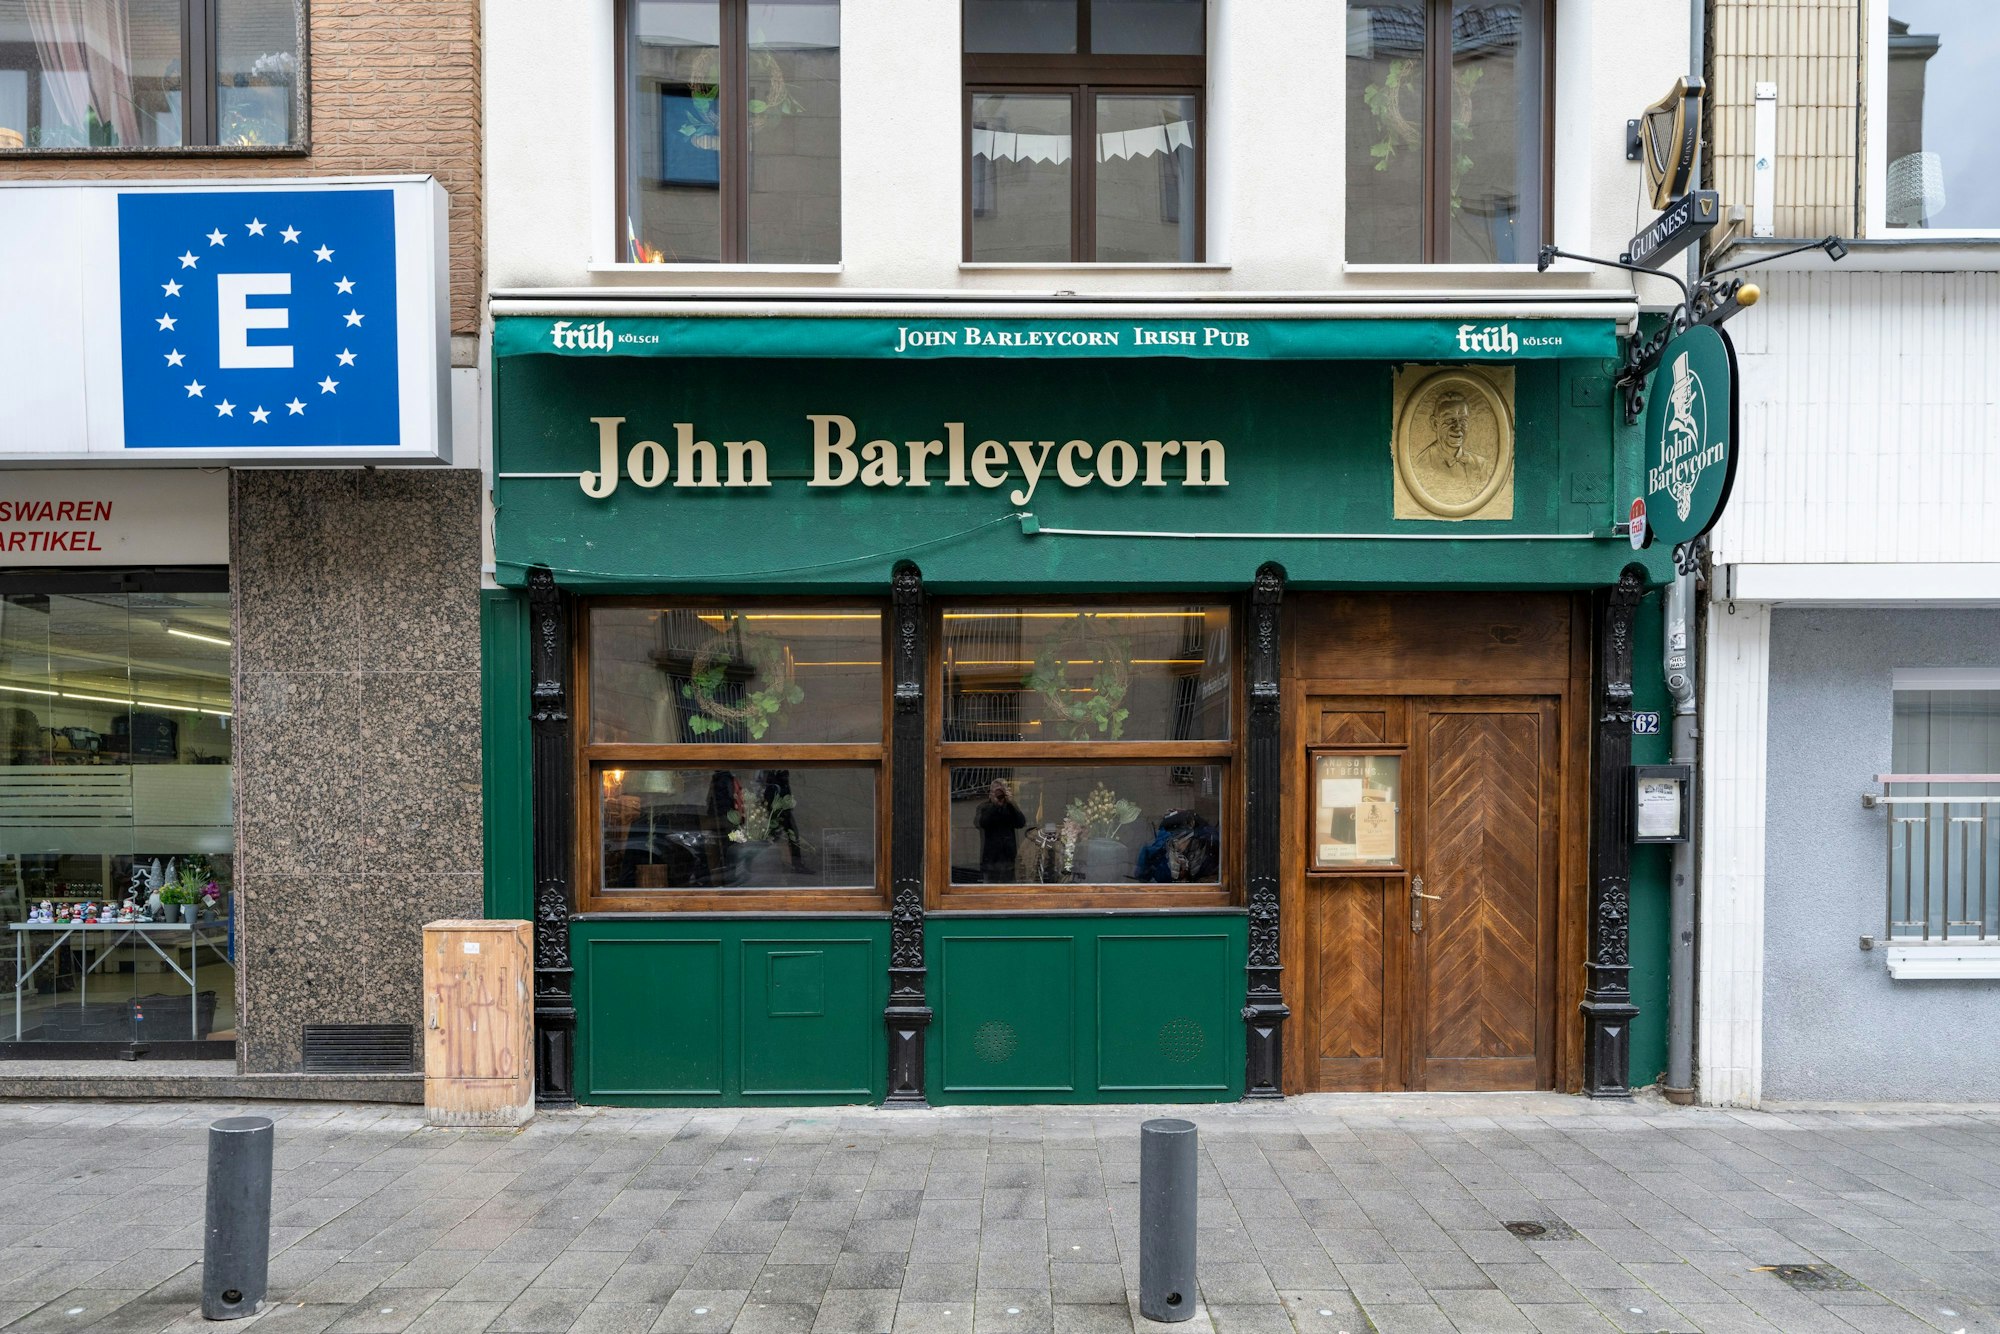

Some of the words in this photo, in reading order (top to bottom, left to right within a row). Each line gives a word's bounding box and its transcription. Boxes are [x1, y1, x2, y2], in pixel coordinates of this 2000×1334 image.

[1632, 206, 1689, 262] GUINNESS
[217, 272, 295, 369] E
[550, 321, 614, 353] früh
[617, 332, 660, 345] KÖLSCH
[895, 326, 957, 352] JOHN
[964, 326, 1120, 346] BARLEYCORN
[1132, 326, 1197, 347] IRISH
[1203, 326, 1250, 347] PUB
[1456, 323, 1519, 355] früh
[1522, 336, 1563, 347] KÖLSCH
[579, 416, 772, 499] John
[806, 413, 1230, 507] Barleycorn
[1659, 431, 1693, 471] John
[1648, 441, 1724, 496] Barleycorn
[0, 501, 113, 522] SWAREN
[1635, 714, 1658, 733] 62
[1323, 759, 1342, 767] AND
[1347, 759, 1360, 767] SO
[1326, 768, 1335, 776] IT
